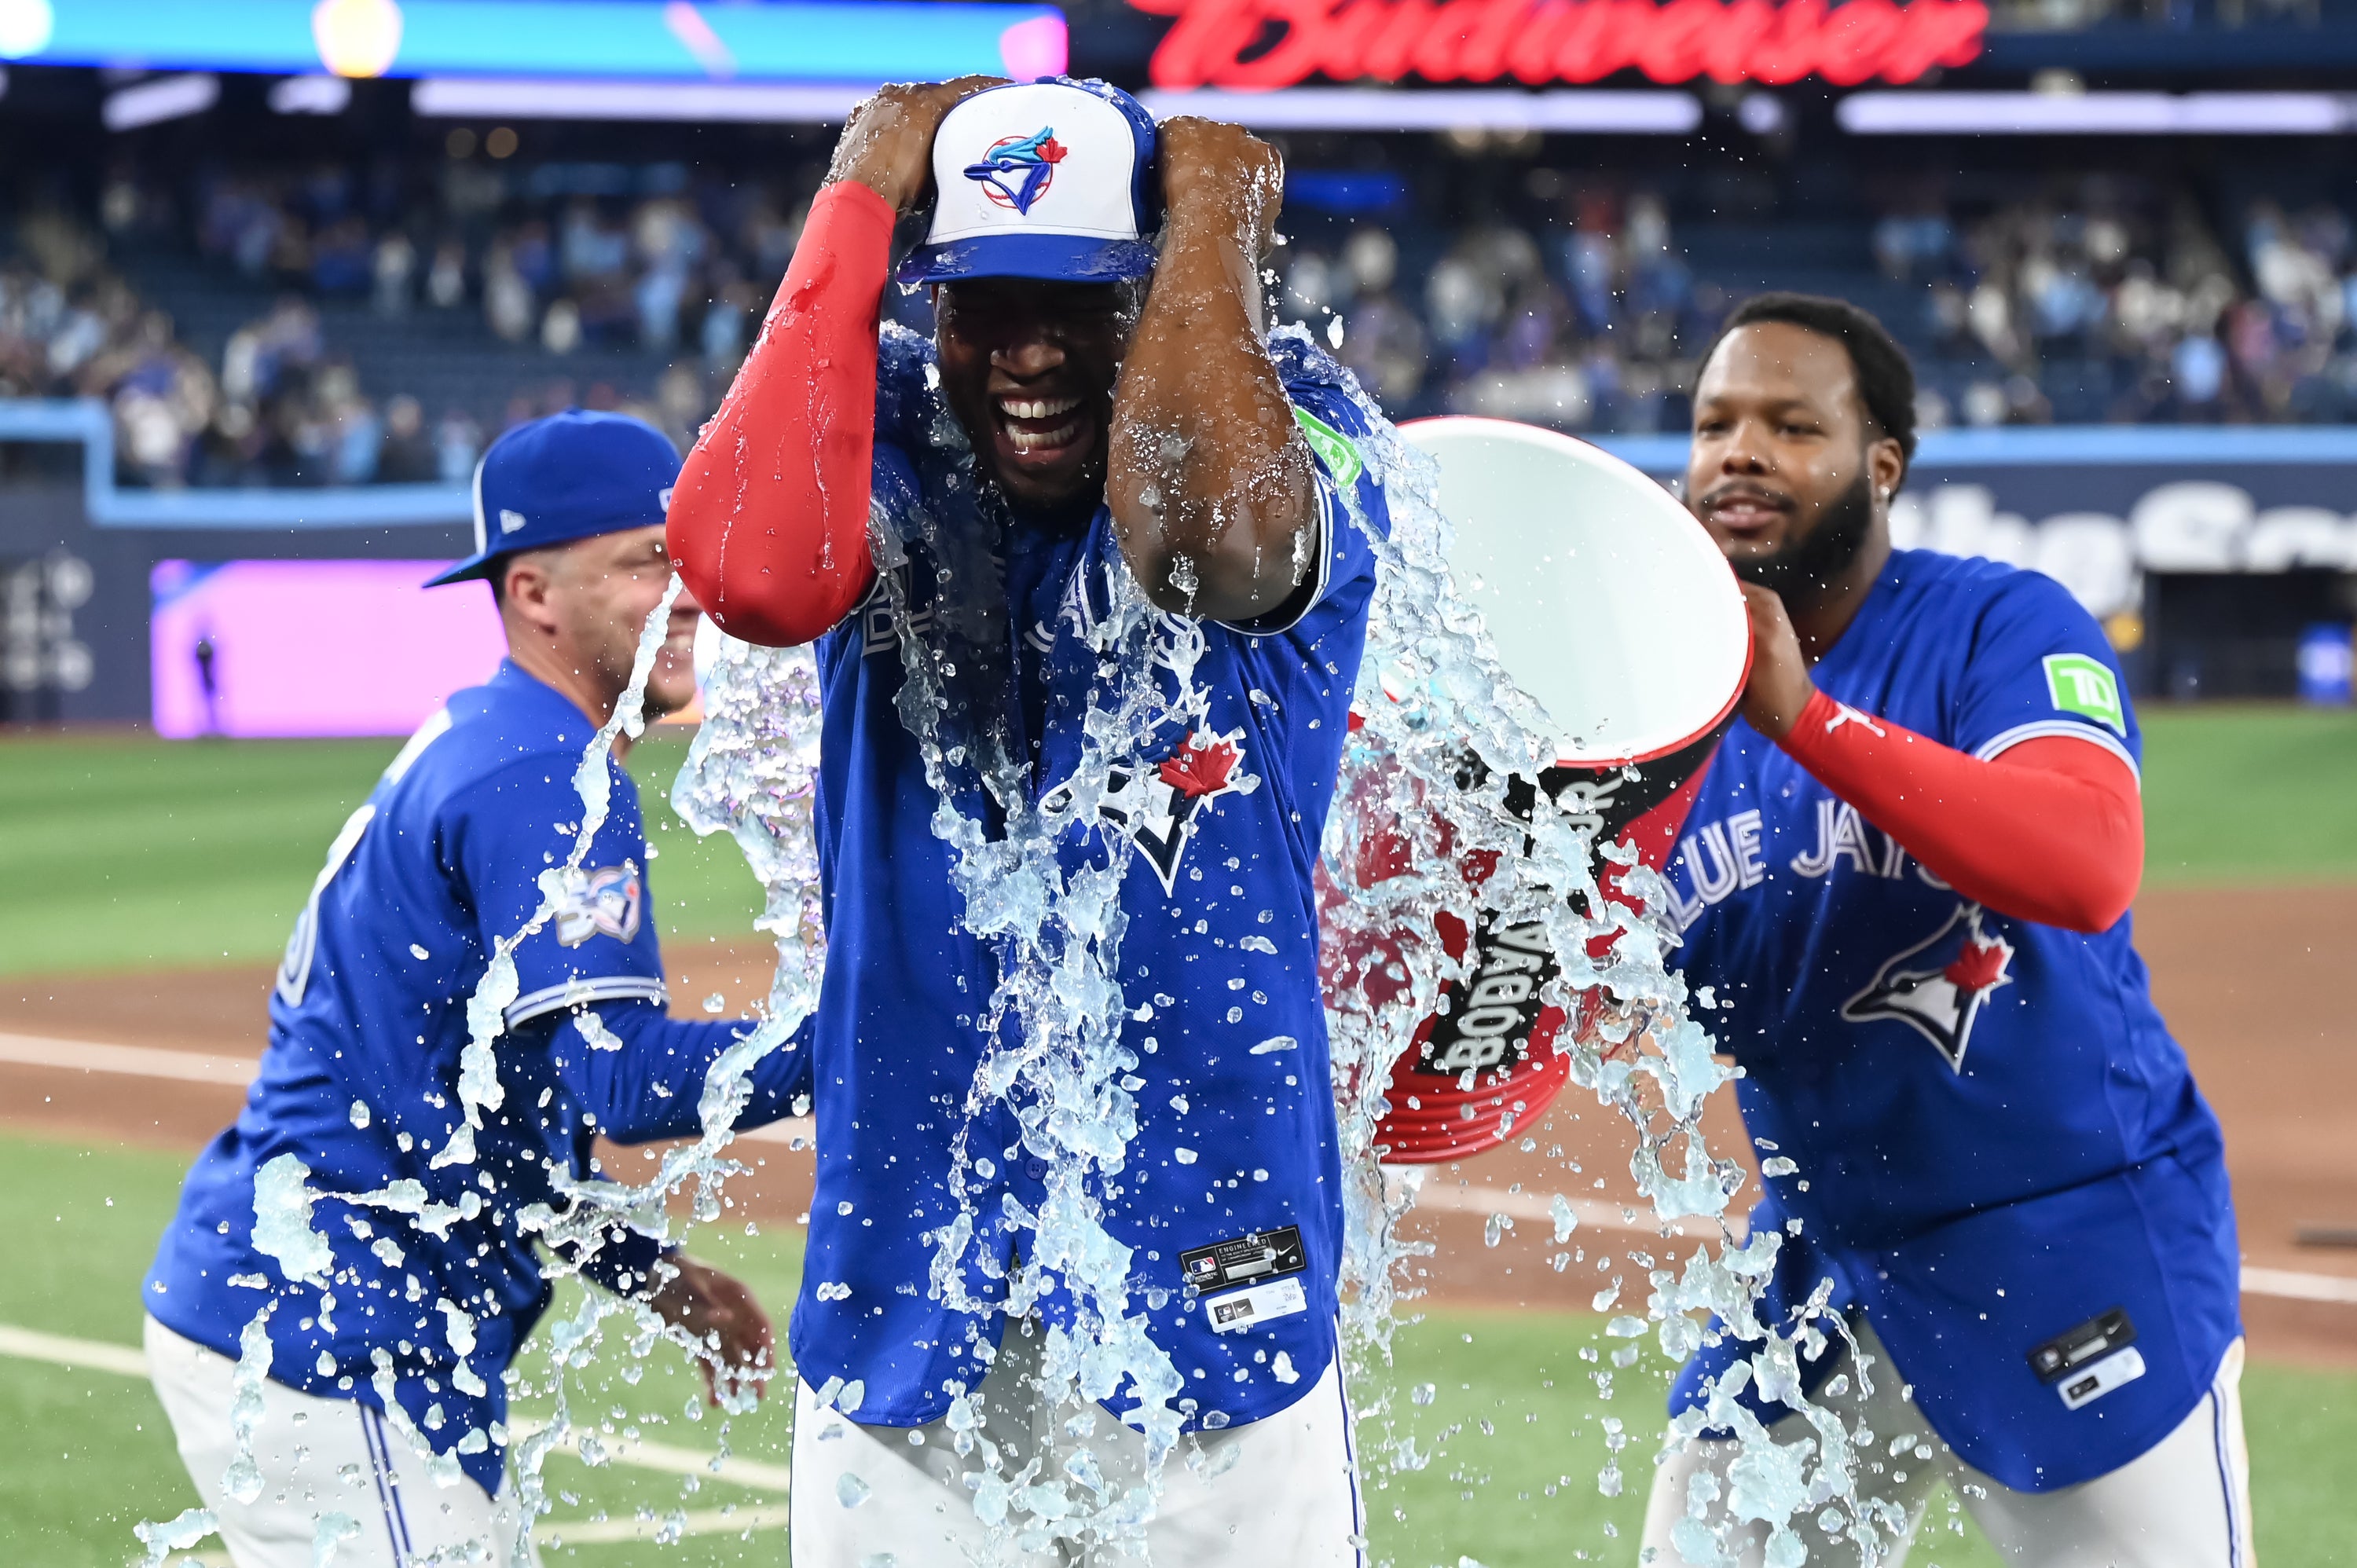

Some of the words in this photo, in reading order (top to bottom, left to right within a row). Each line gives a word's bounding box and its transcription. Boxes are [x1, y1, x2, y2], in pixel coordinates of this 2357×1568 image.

[1134, 0, 1990, 93] Budweiser
[2059, 668, 2115, 713] TD
[1790, 798, 1952, 890] JA
[1444, 775, 1623, 1071] BODYAR
[1219, 1238, 1266, 1255] ENGINEERED
